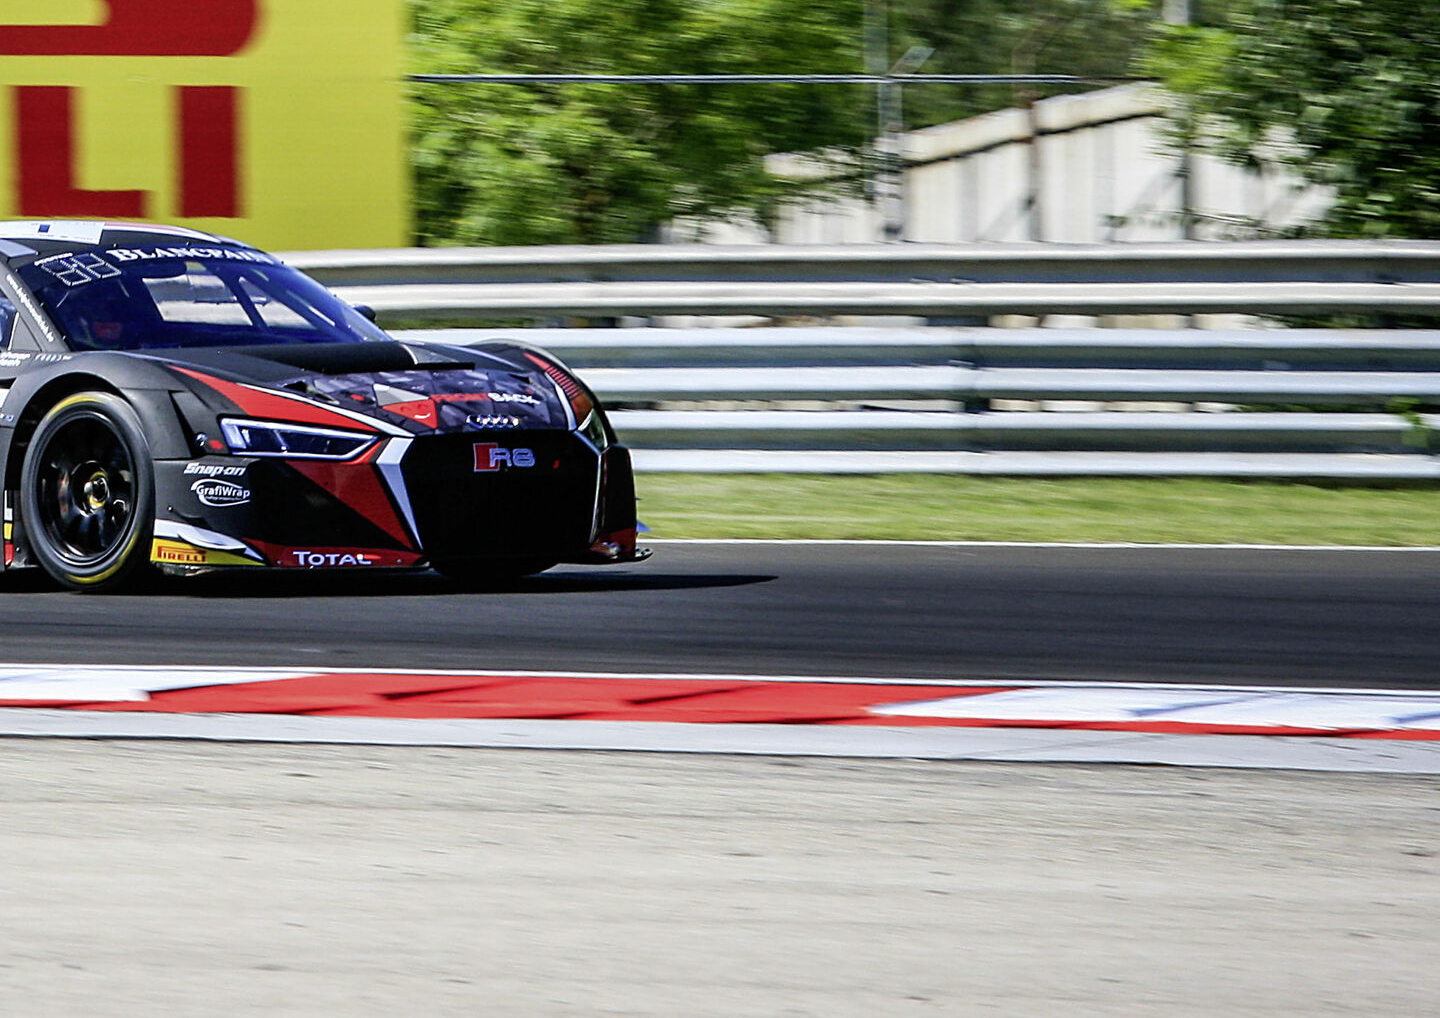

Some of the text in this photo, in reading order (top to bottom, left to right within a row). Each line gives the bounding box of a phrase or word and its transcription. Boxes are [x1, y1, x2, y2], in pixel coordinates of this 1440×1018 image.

[106, 248, 273, 265] BLANCPAIN
[489, 447, 535, 468] R8
[183, 462, 247, 477] Snap-on
[196, 485, 251, 499] GrafiWrap
[158, 546, 207, 562] PIRELLI
[292, 551, 372, 566] TOTAL
